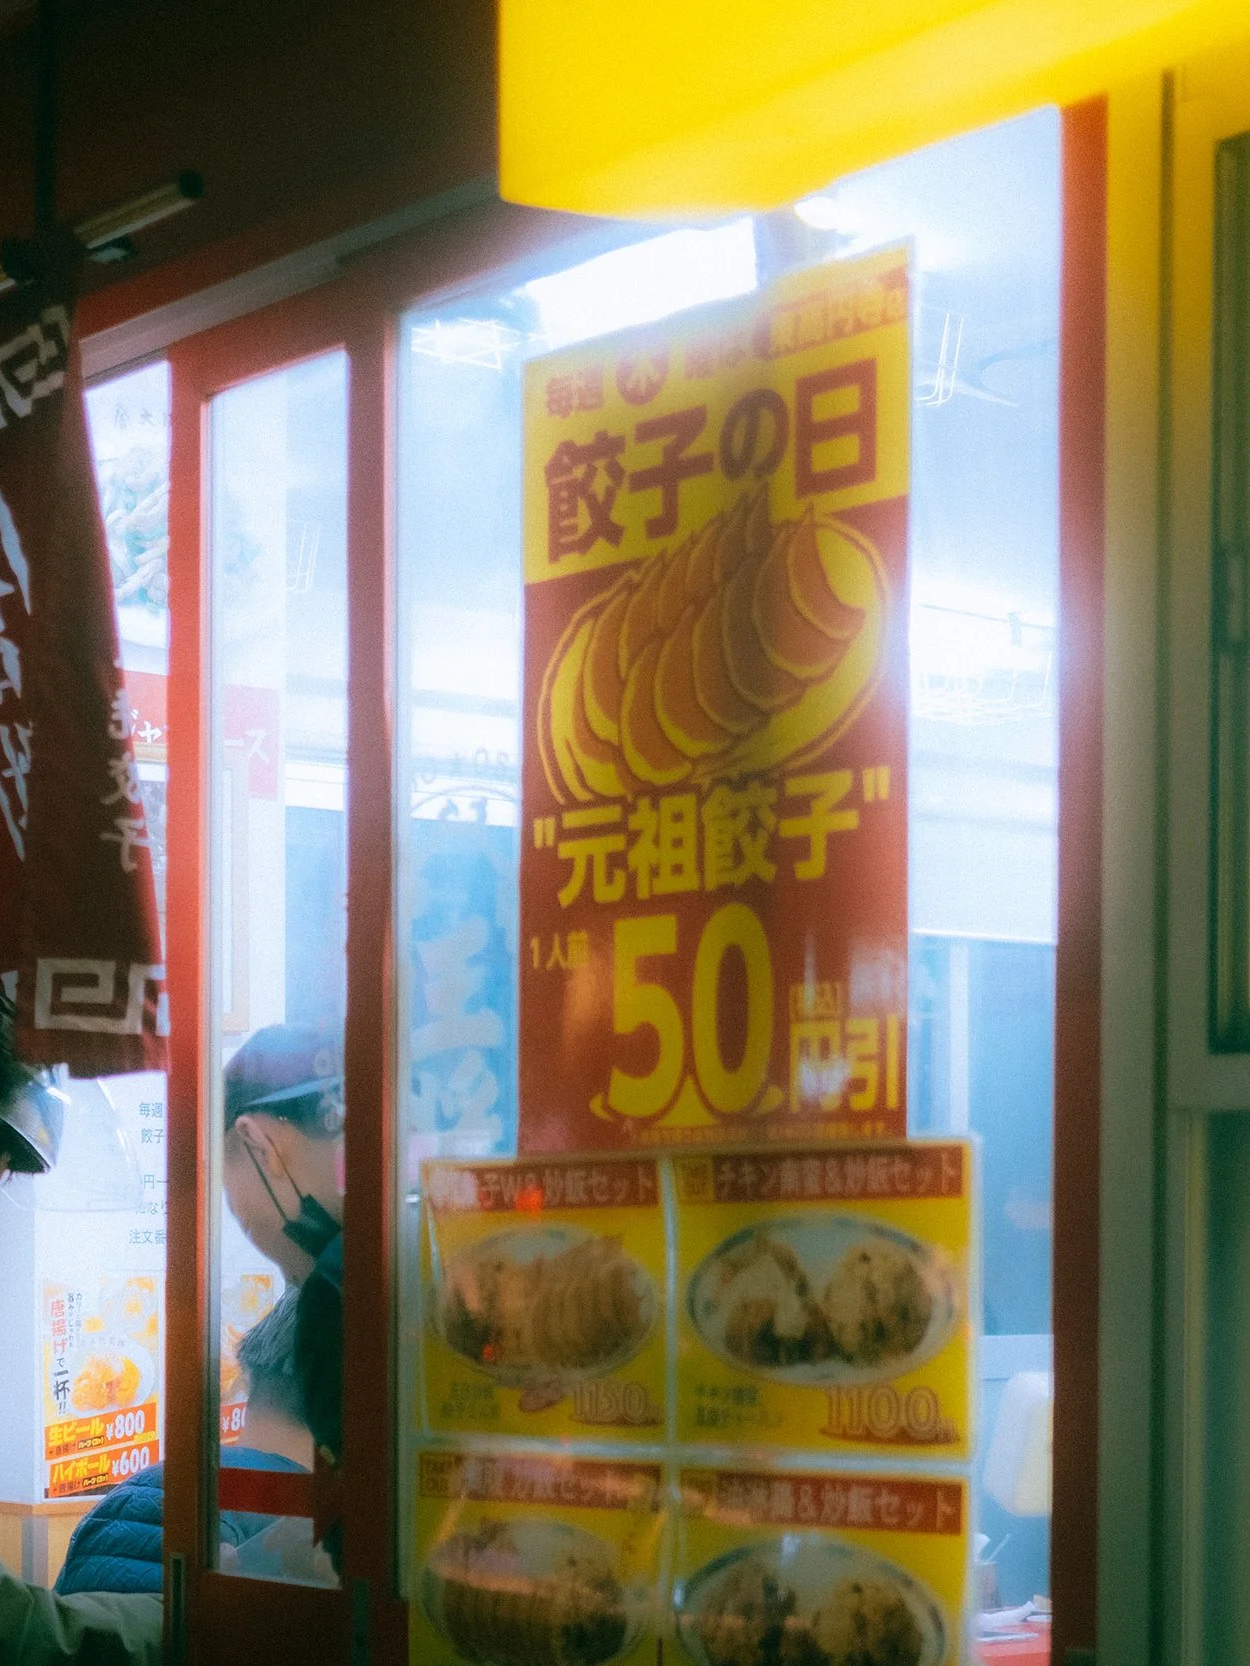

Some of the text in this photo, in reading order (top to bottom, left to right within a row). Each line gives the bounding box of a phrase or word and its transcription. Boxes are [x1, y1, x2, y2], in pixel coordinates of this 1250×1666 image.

[544, 356, 880, 564] 餃子の日
[605, 903, 774, 1118] 50
[47, 1409, 145, 1447] 生ビール ¥800
[52, 1446, 150, 1483] ハイボール ¥600
